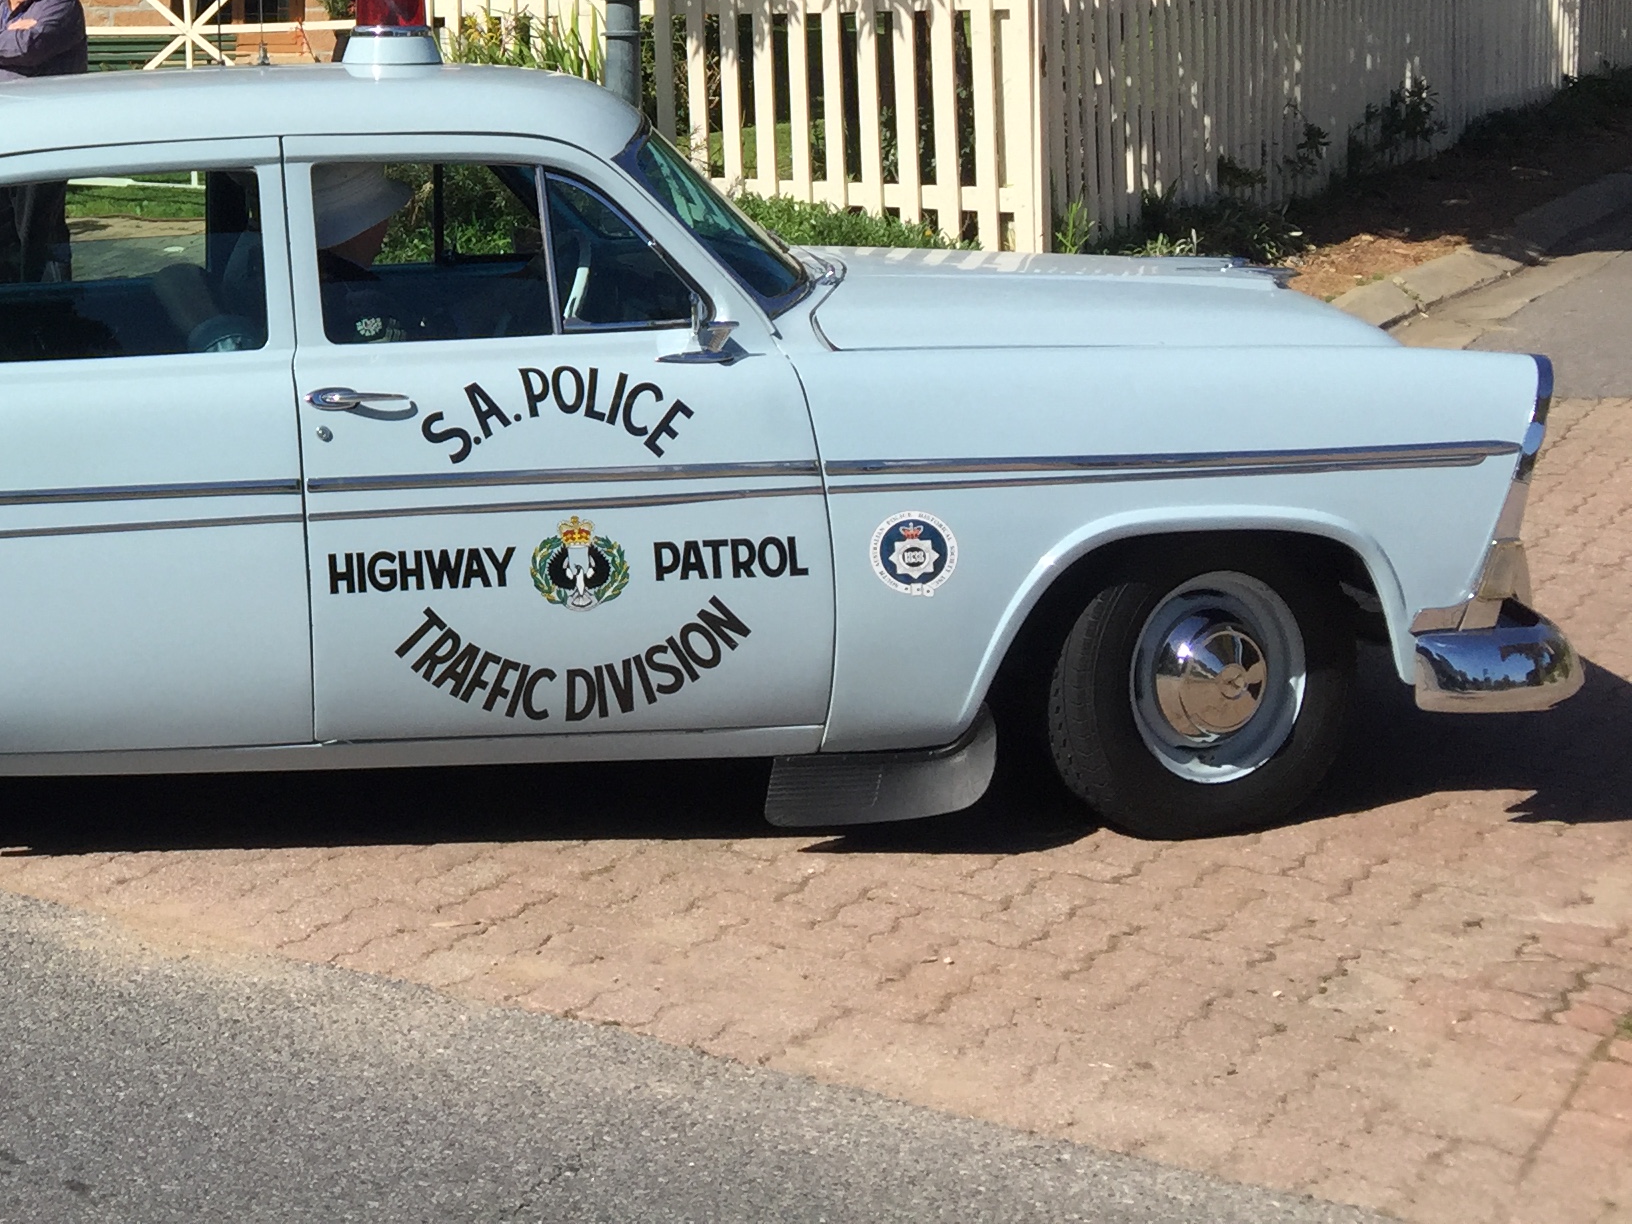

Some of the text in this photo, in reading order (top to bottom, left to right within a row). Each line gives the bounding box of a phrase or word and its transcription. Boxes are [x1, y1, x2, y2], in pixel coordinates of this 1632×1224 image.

[422, 365, 694, 464] S.A. POLICE
[328, 536, 809, 595] HIGHWAY PATROL
[886, 513, 912, 525] POLICE
[918, 513, 952, 541] HISTORICAL
[394, 595, 752, 723] TRAFFIC DIVISION
